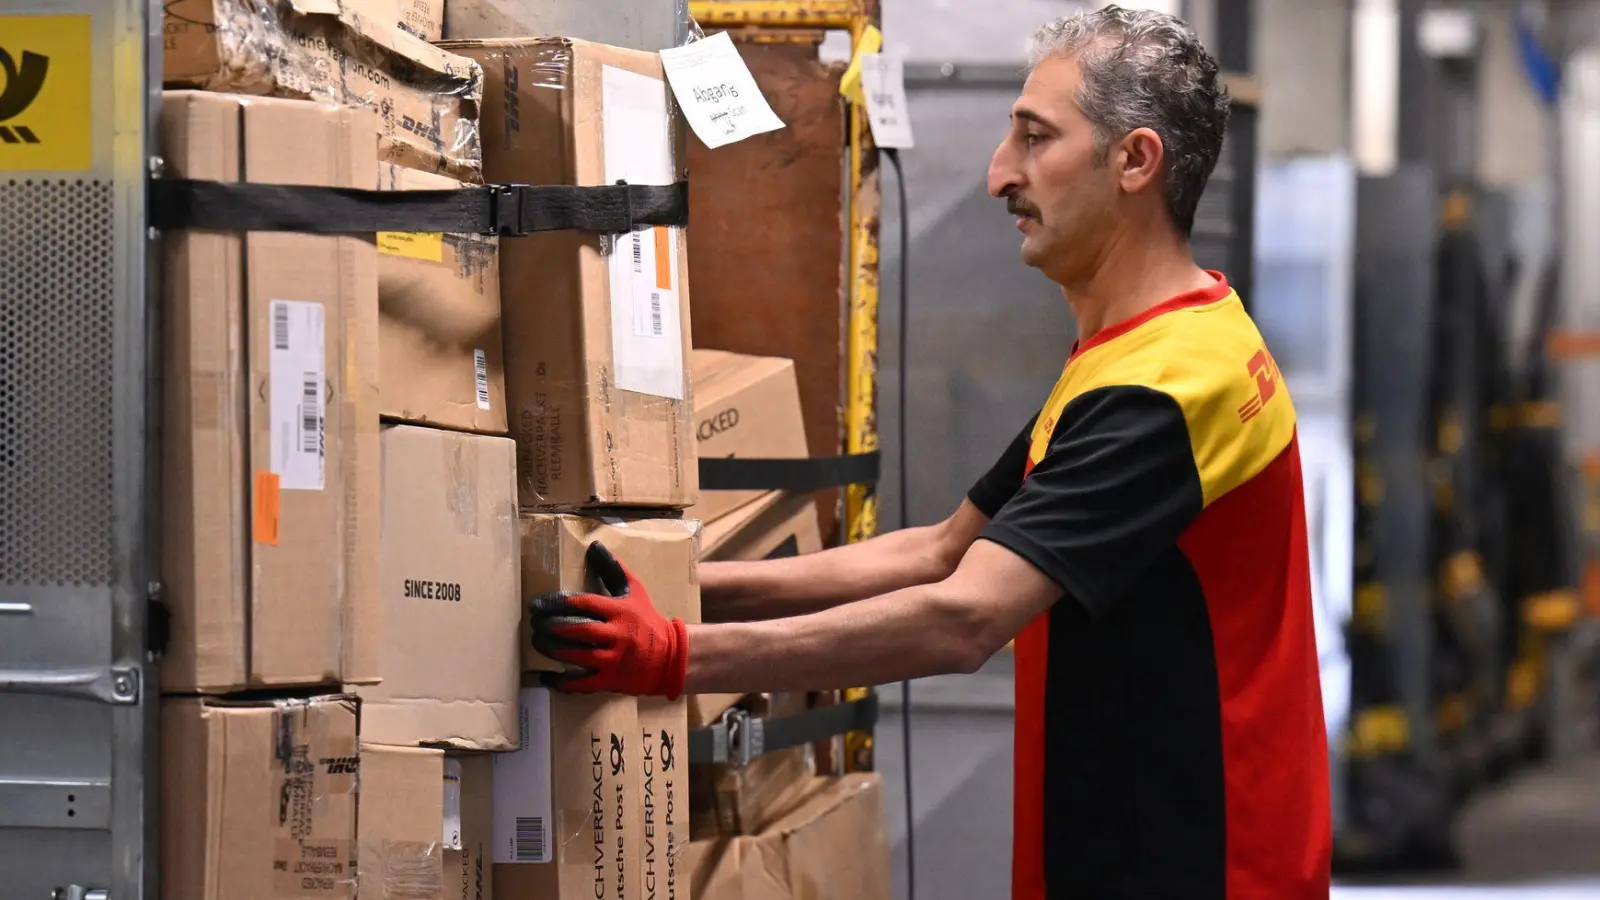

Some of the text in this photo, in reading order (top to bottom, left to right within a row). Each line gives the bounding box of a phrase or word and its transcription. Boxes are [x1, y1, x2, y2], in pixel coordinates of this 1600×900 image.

[693, 81, 739, 104] Abgang
[404, 578, 461, 602] SINCE 2008
[591, 732, 605, 900] CHVERPACKT
[614, 783, 624, 831] Post
[664, 779, 674, 826] Post
